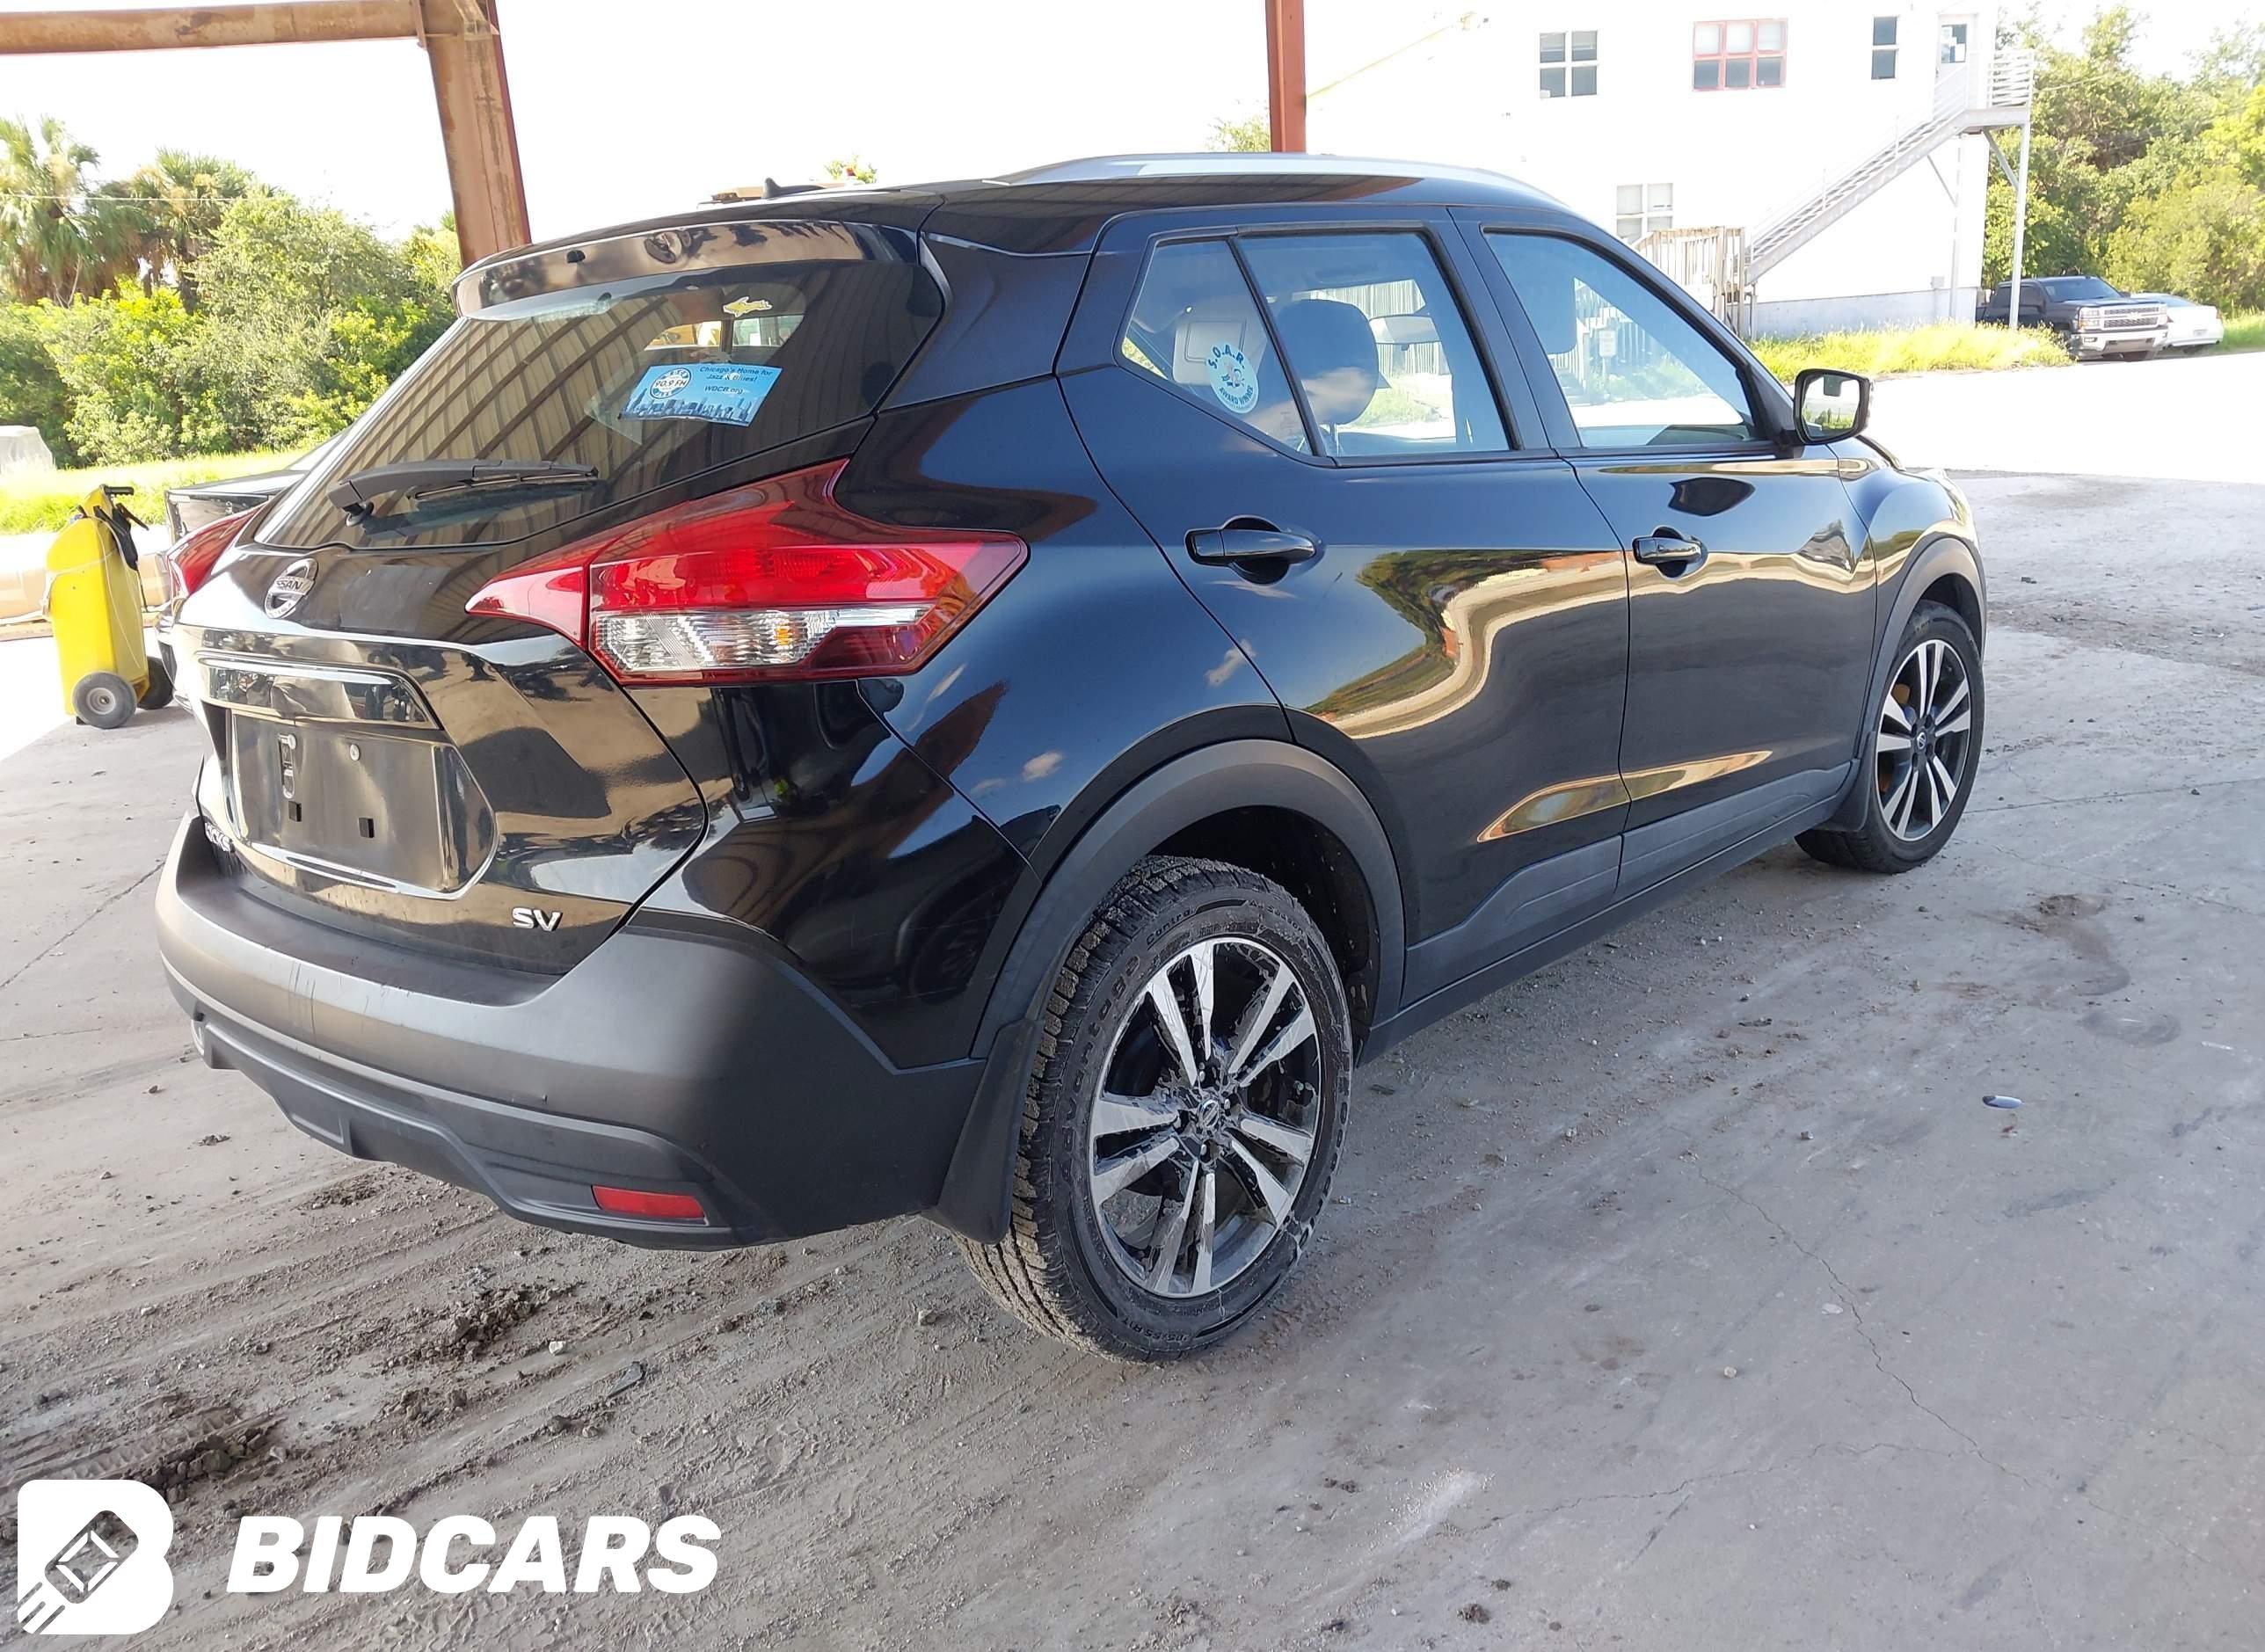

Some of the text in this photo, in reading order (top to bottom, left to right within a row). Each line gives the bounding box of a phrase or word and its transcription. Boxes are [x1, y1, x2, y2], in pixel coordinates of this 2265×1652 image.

[1208, 344, 1245, 369] S.O.A.R.
[704, 385, 744, 395] WDCB.org
[512, 906, 563, 932] SV
